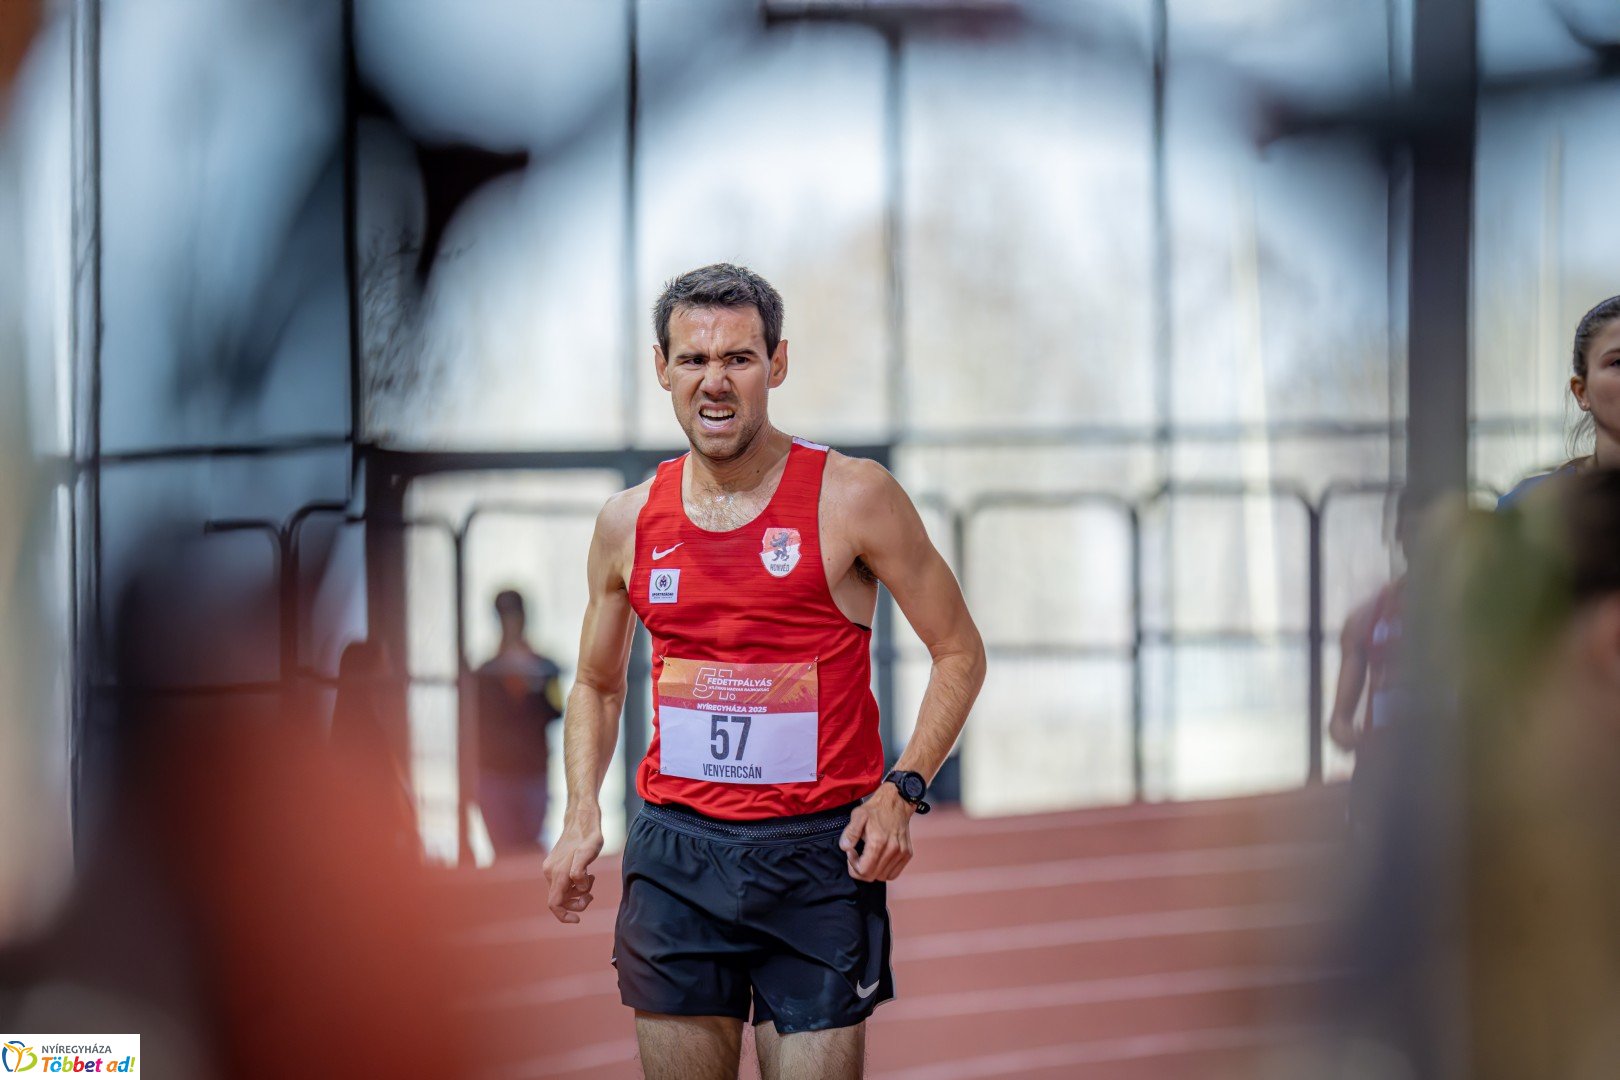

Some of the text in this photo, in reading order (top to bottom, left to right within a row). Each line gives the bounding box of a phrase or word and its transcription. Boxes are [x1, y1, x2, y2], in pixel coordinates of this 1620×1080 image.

[707, 677, 772, 687] FEDETTPÁLYÁS
[697, 703, 746, 713] NYÍREGYHÁZA
[710, 714, 752, 761] 57
[702, 763, 762, 779] VENYERCSÁN
